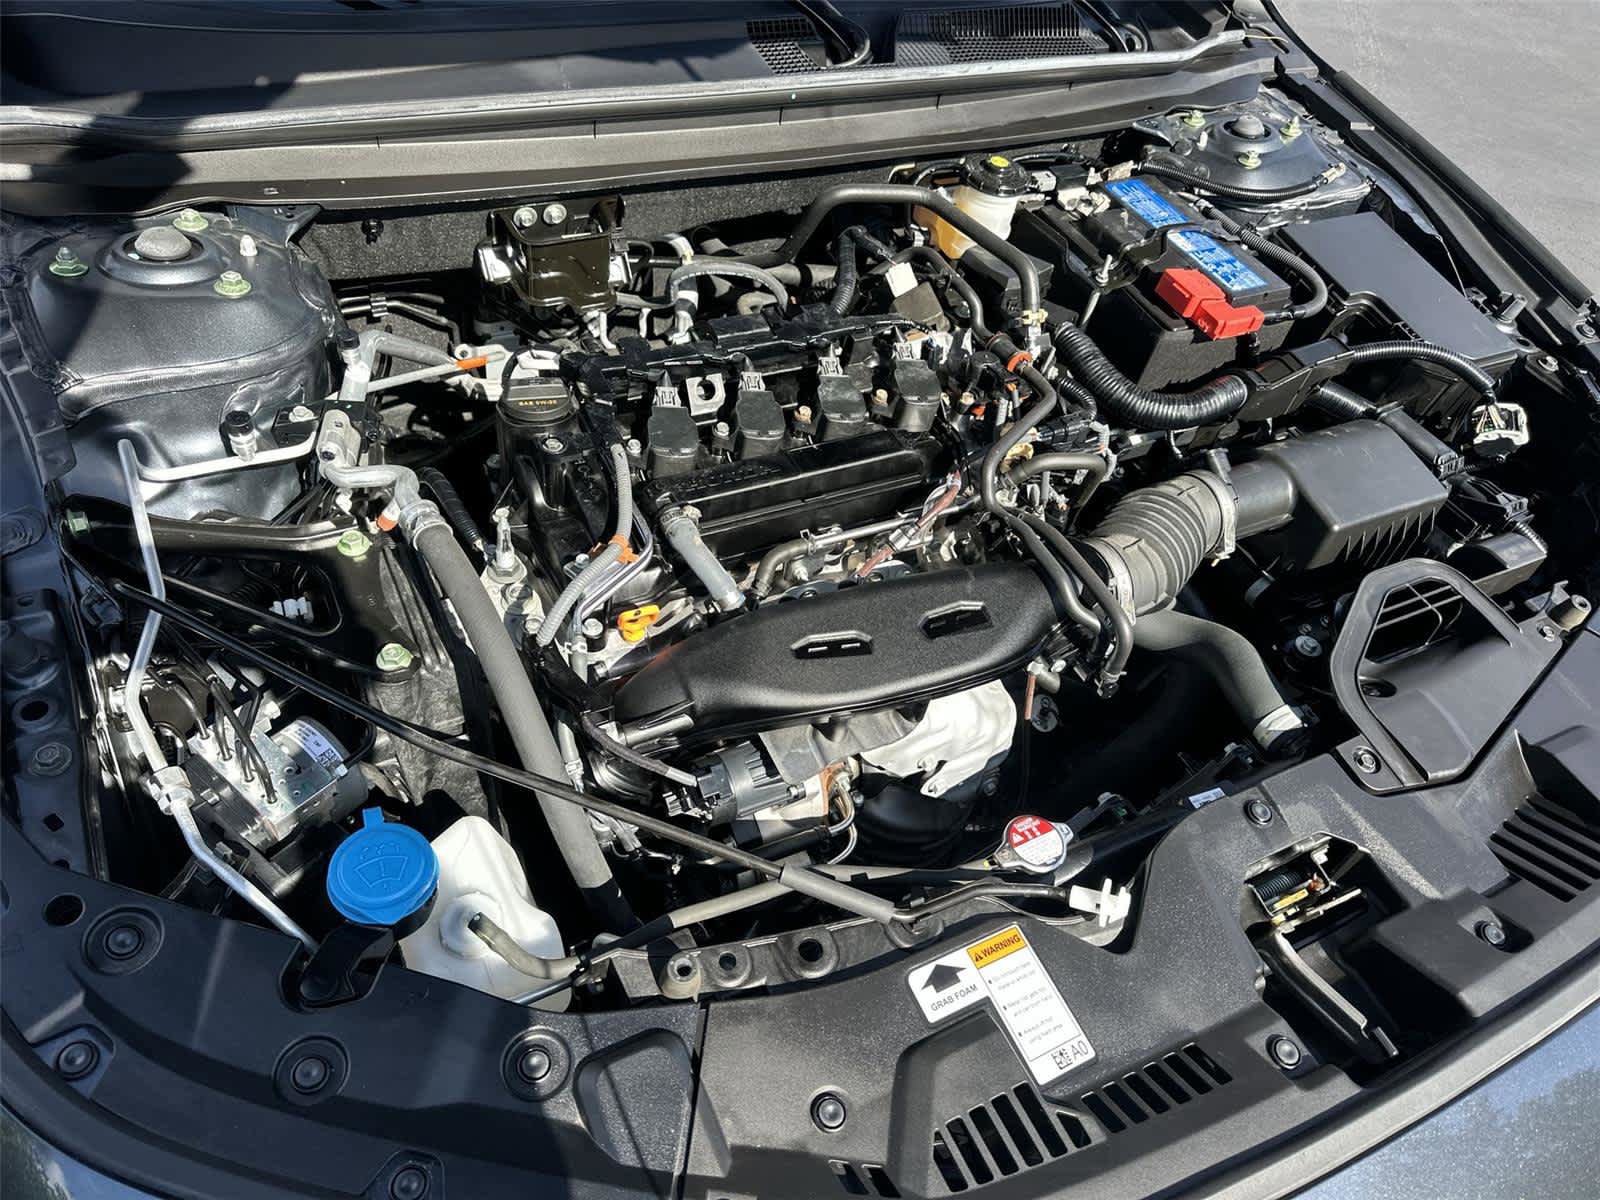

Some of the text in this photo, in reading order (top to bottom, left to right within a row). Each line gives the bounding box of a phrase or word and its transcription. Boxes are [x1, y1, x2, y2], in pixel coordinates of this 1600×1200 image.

[981, 934, 1021, 957] WARNING
[930, 984, 979, 1012] GRAB FOAM
